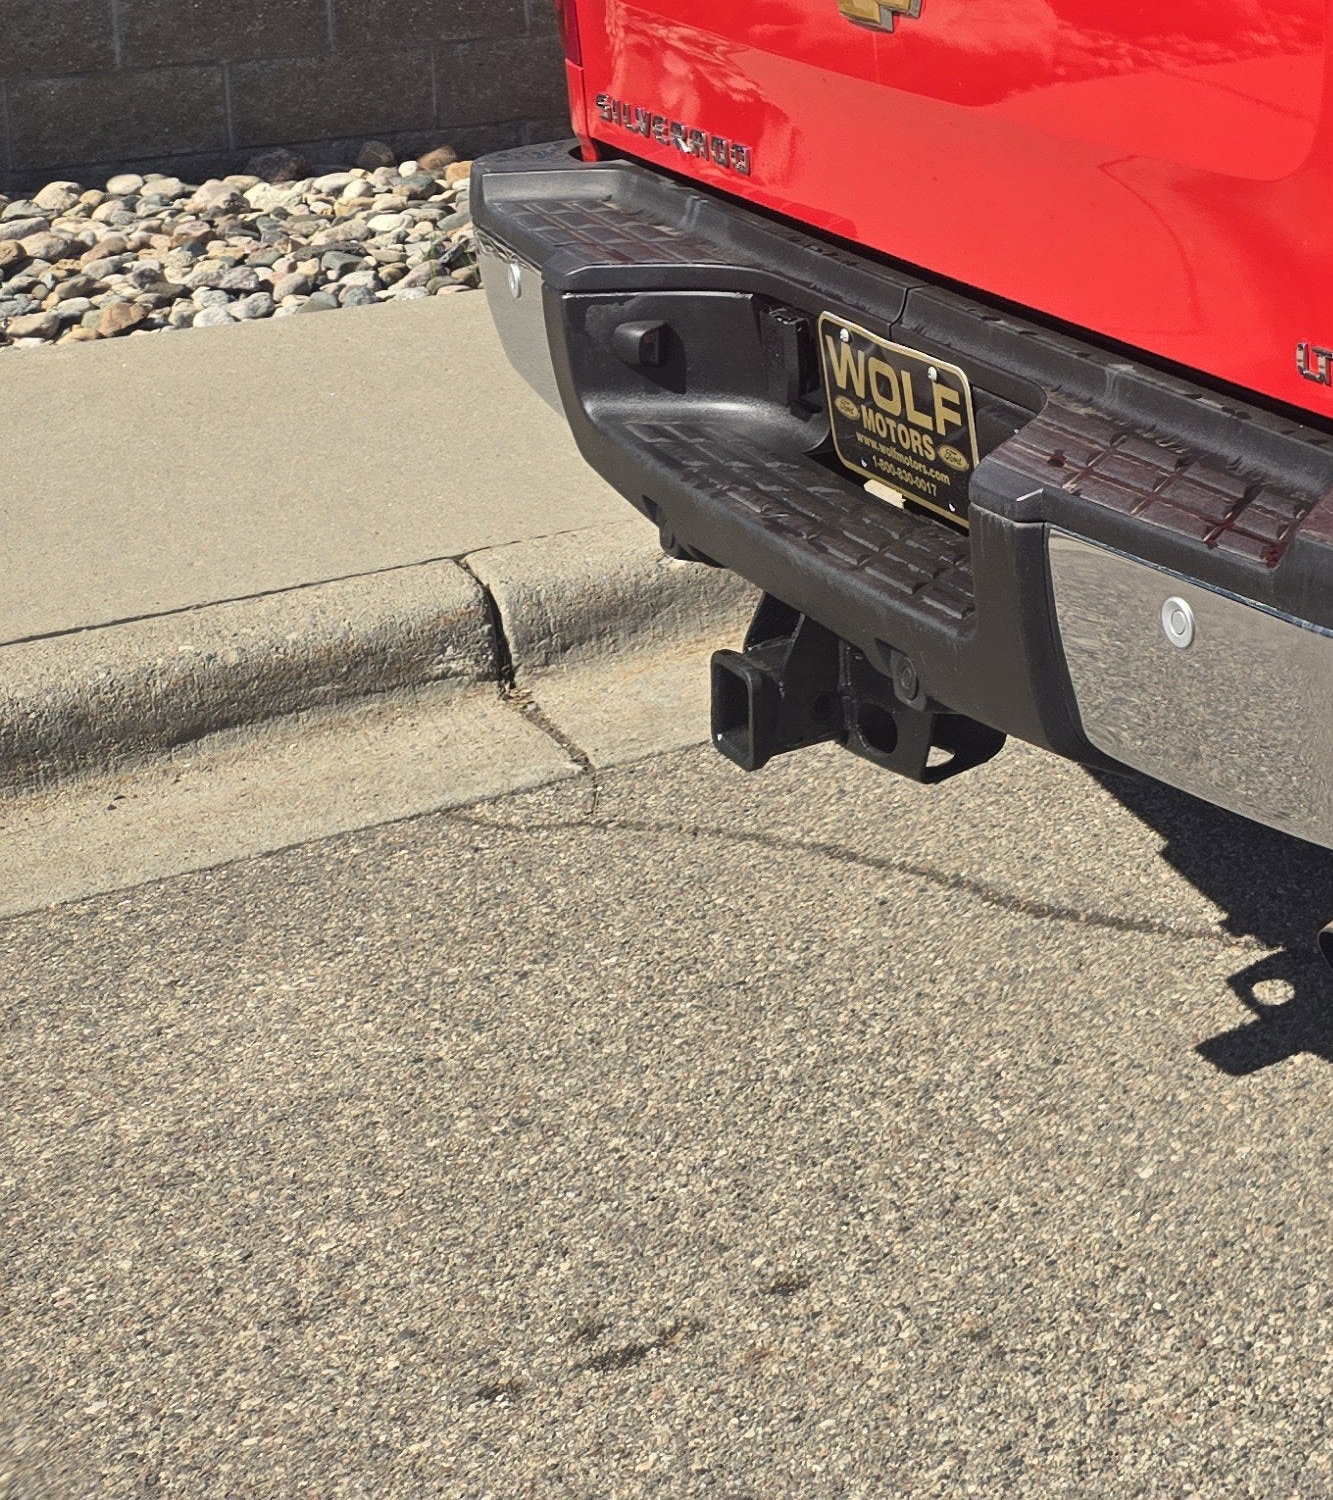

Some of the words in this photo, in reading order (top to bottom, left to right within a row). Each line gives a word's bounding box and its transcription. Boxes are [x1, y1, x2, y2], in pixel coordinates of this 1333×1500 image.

[595, 92, 752, 177] SILVERADO
[825, 334, 962, 436] WOLF
[855, 431, 951, 486] www.wolfmotors.com
[860, 404, 937, 462] MOTORS
